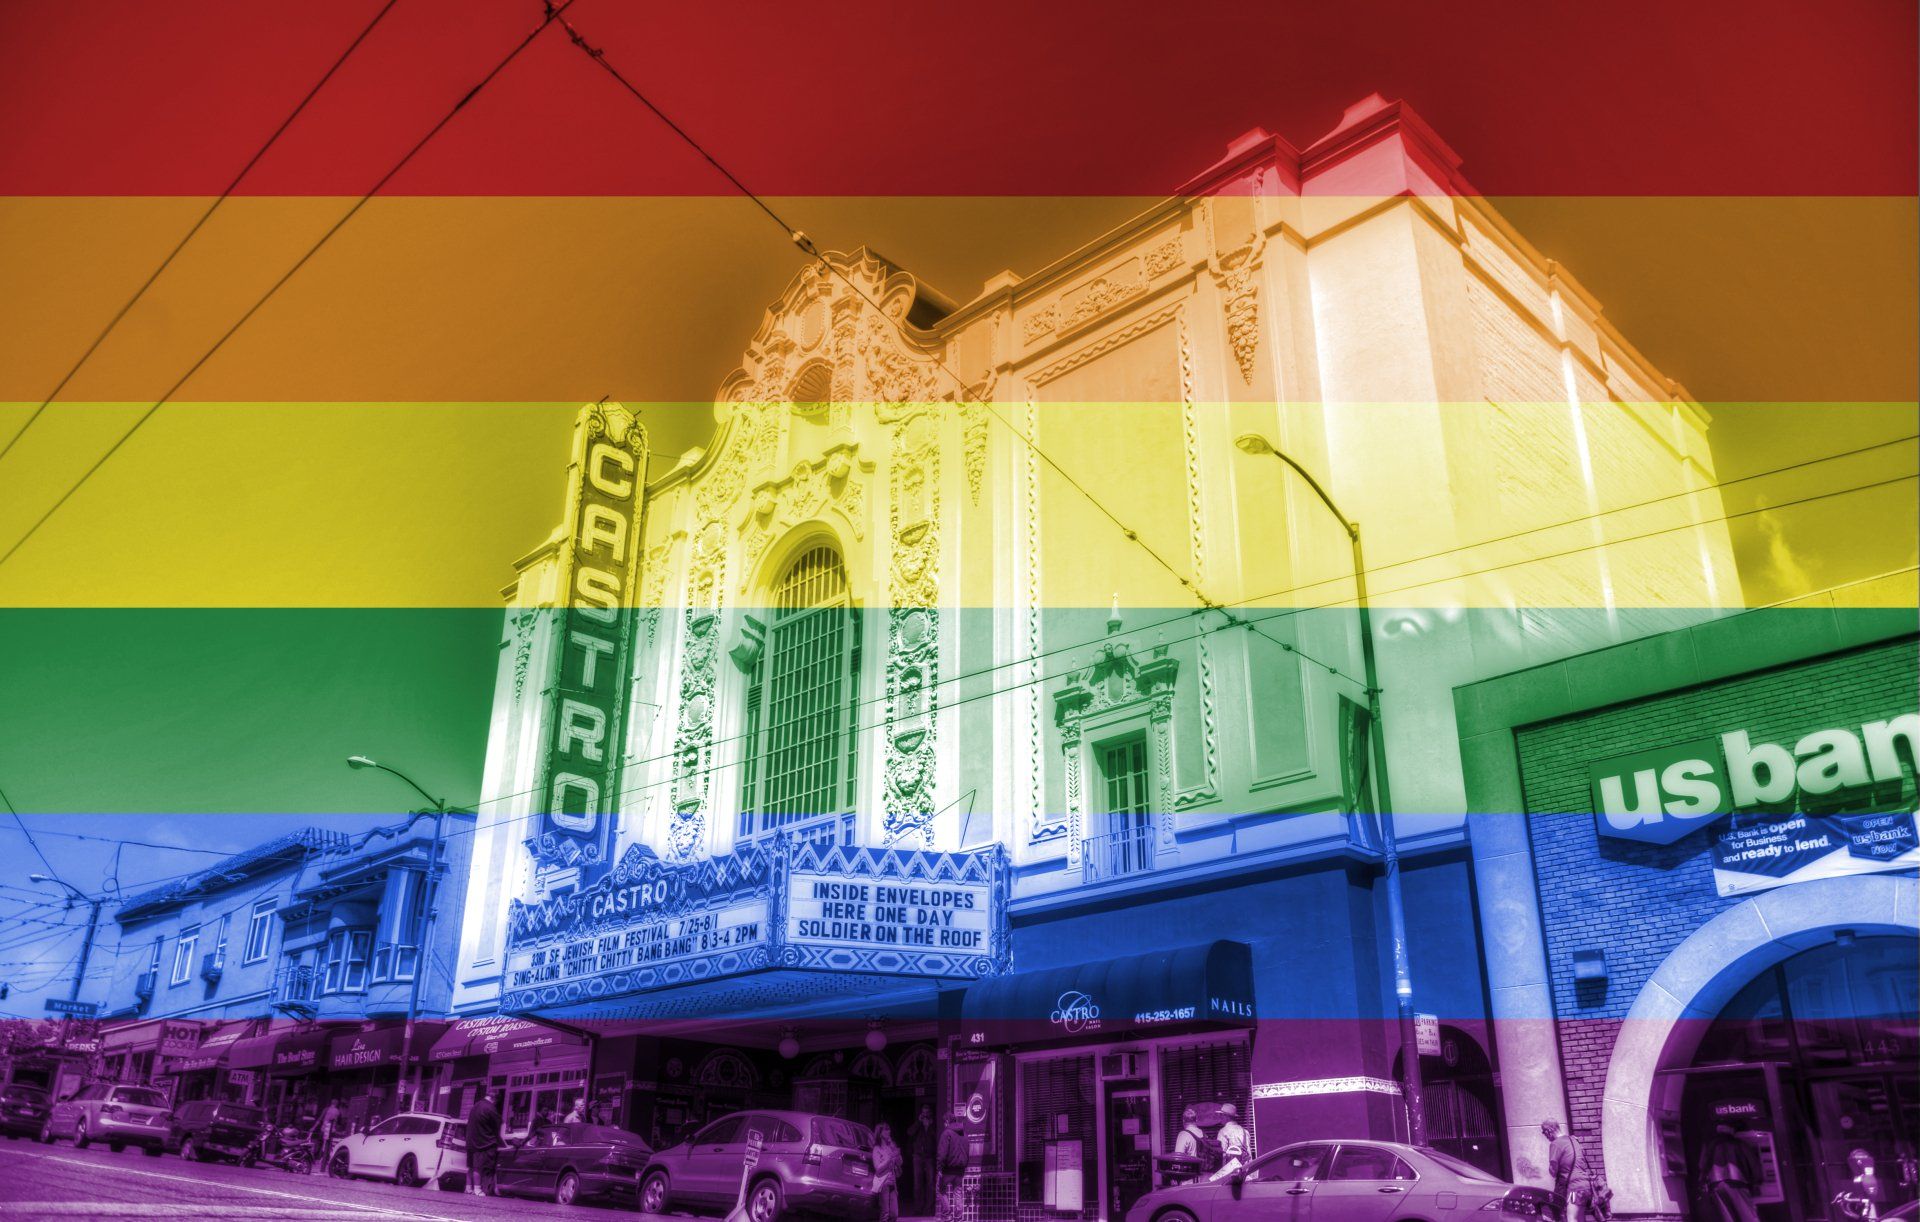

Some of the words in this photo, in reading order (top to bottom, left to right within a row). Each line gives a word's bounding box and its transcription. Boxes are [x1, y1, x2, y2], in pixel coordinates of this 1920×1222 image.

[550, 442, 635, 834] CASTRO
[1737, 829, 1760, 839] Bank
[1760, 827, 1769, 835] is
[1769, 818, 1806, 834] open
[1863, 816, 1894, 829] OPEN
[1722, 853, 1740, 863] and
[1741, 844, 1782, 860] ready
[1784, 845, 1794, 853] to
[1795, 835, 1832, 851] lend.
[1731, 841, 1745, 850] for
[1745, 834, 1788, 848] Business
[1871, 843, 1897, 855] NOW
[592, 879, 668, 918] CASTRO
[813, 882, 869, 902] INSIDE
[876, 886, 974, 909] ENVELOPES
[822, 902, 866, 921] HERE
[875, 906, 907, 924] ONE
[917, 909, 954, 926] DAY
[530, 951, 546, 968] 33RD
[549, 949, 561, 963] SF
[562, 940, 594, 961] JEWISH
[597, 935, 620, 953] FILM
[625, 924, 669, 948] FESTIVAL
[679, 913, 718, 936] 7/25-8/1
[799, 920, 871, 941] SOLDIER
[876, 925, 897, 943] ON
[903, 927, 934, 944] THE
[941, 929, 981, 947] ROOF
[513, 964, 560, 986] SING-ALONG
[600, 949, 634, 969] CHITTY
[638, 943, 663, 962] BANG
[735, 924, 758, 943] 2PM
[53, 1002, 89, 1013] Market
[1050, 1005, 1099, 1024] CASTRO
[1134, 1006, 1196, 1024] 415-252-1657
[1211, 997, 1252, 1017] NAILS
[455, 1016, 494, 1031] CASTRO
[467, 1024, 502, 1038] CUSTOM
[165, 1026, 199, 1041] HOT
[970, 1032, 985, 1043] 431
[1864, 1038, 1900, 1056] 443
[334, 1053, 354, 1067] HAIR
[354, 1048, 382, 1065] DESIGN
[1715, 1103, 1756, 1114] usbank
